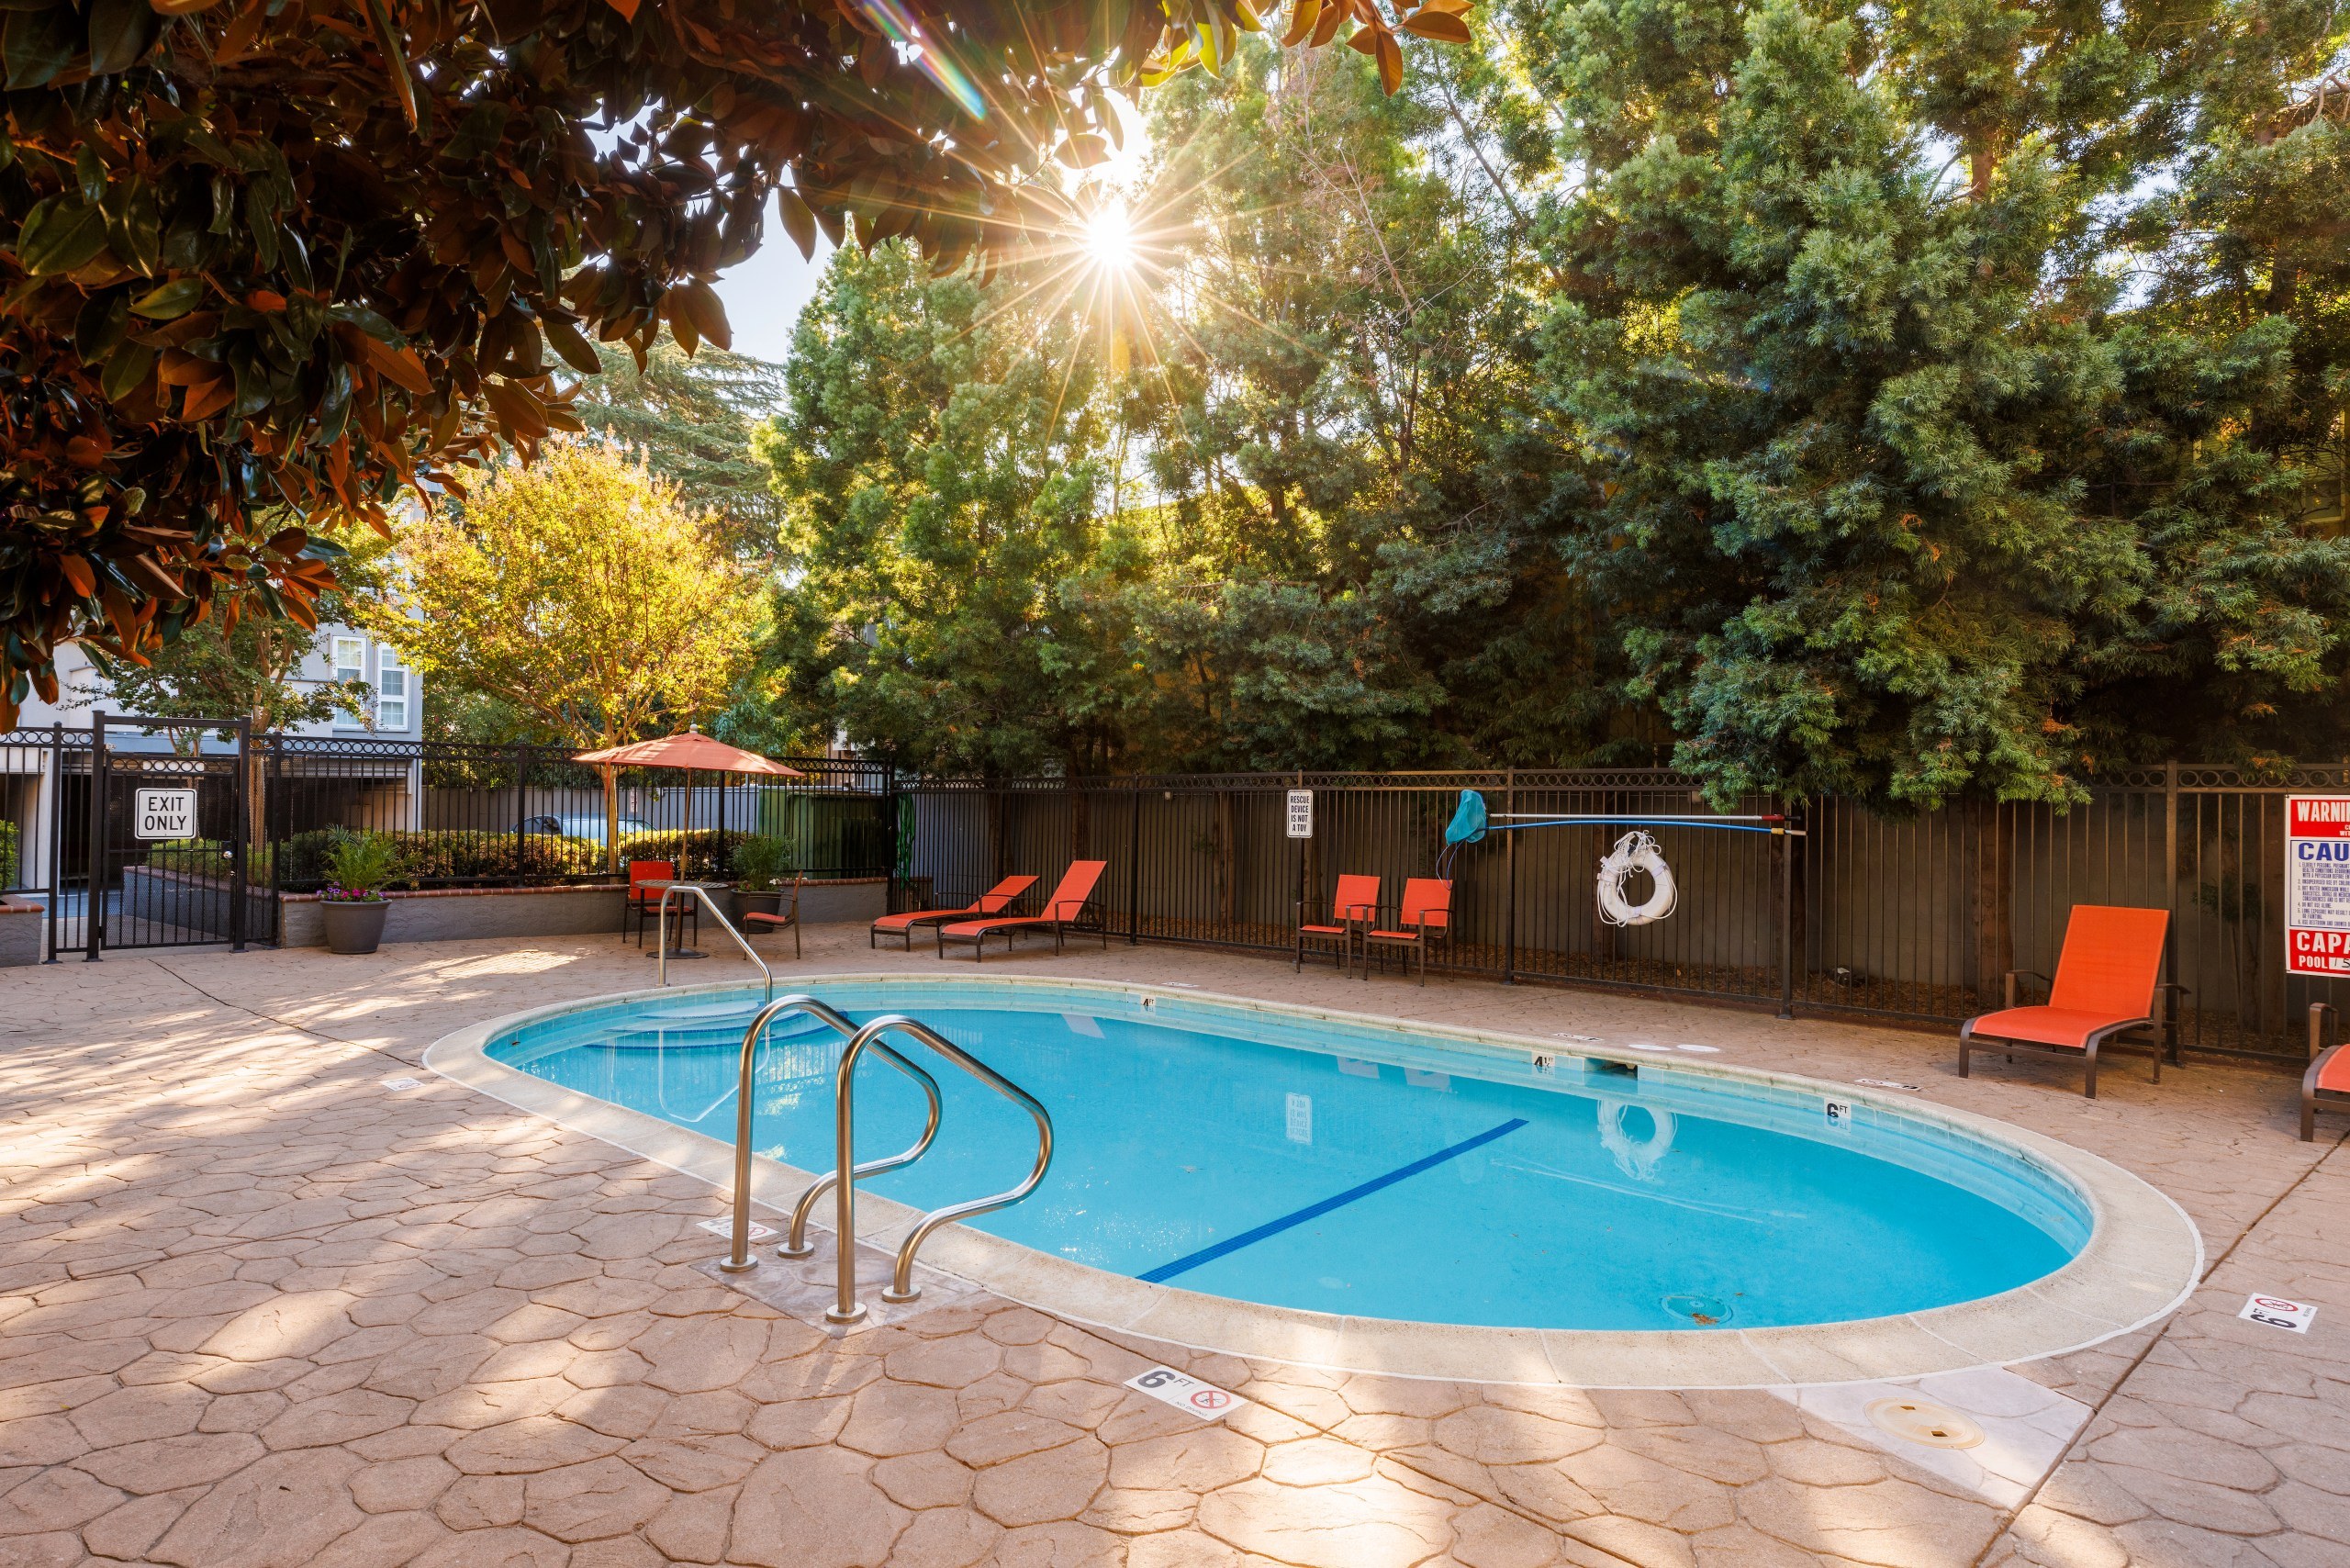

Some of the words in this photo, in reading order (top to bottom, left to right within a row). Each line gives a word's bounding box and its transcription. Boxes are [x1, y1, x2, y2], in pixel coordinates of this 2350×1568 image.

[149, 797, 185, 811] EXIT
[1290, 795, 1309, 804] RESCUE
[145, 815, 186, 830] ONLY
[2299, 842, 2349, 861] CAU
[2299, 955, 2328, 969] POOL
[1839, 1105, 1848, 1114] FT
[1137, 1370, 1175, 1389] 6
[1174, 1378, 1195, 1387] FT
